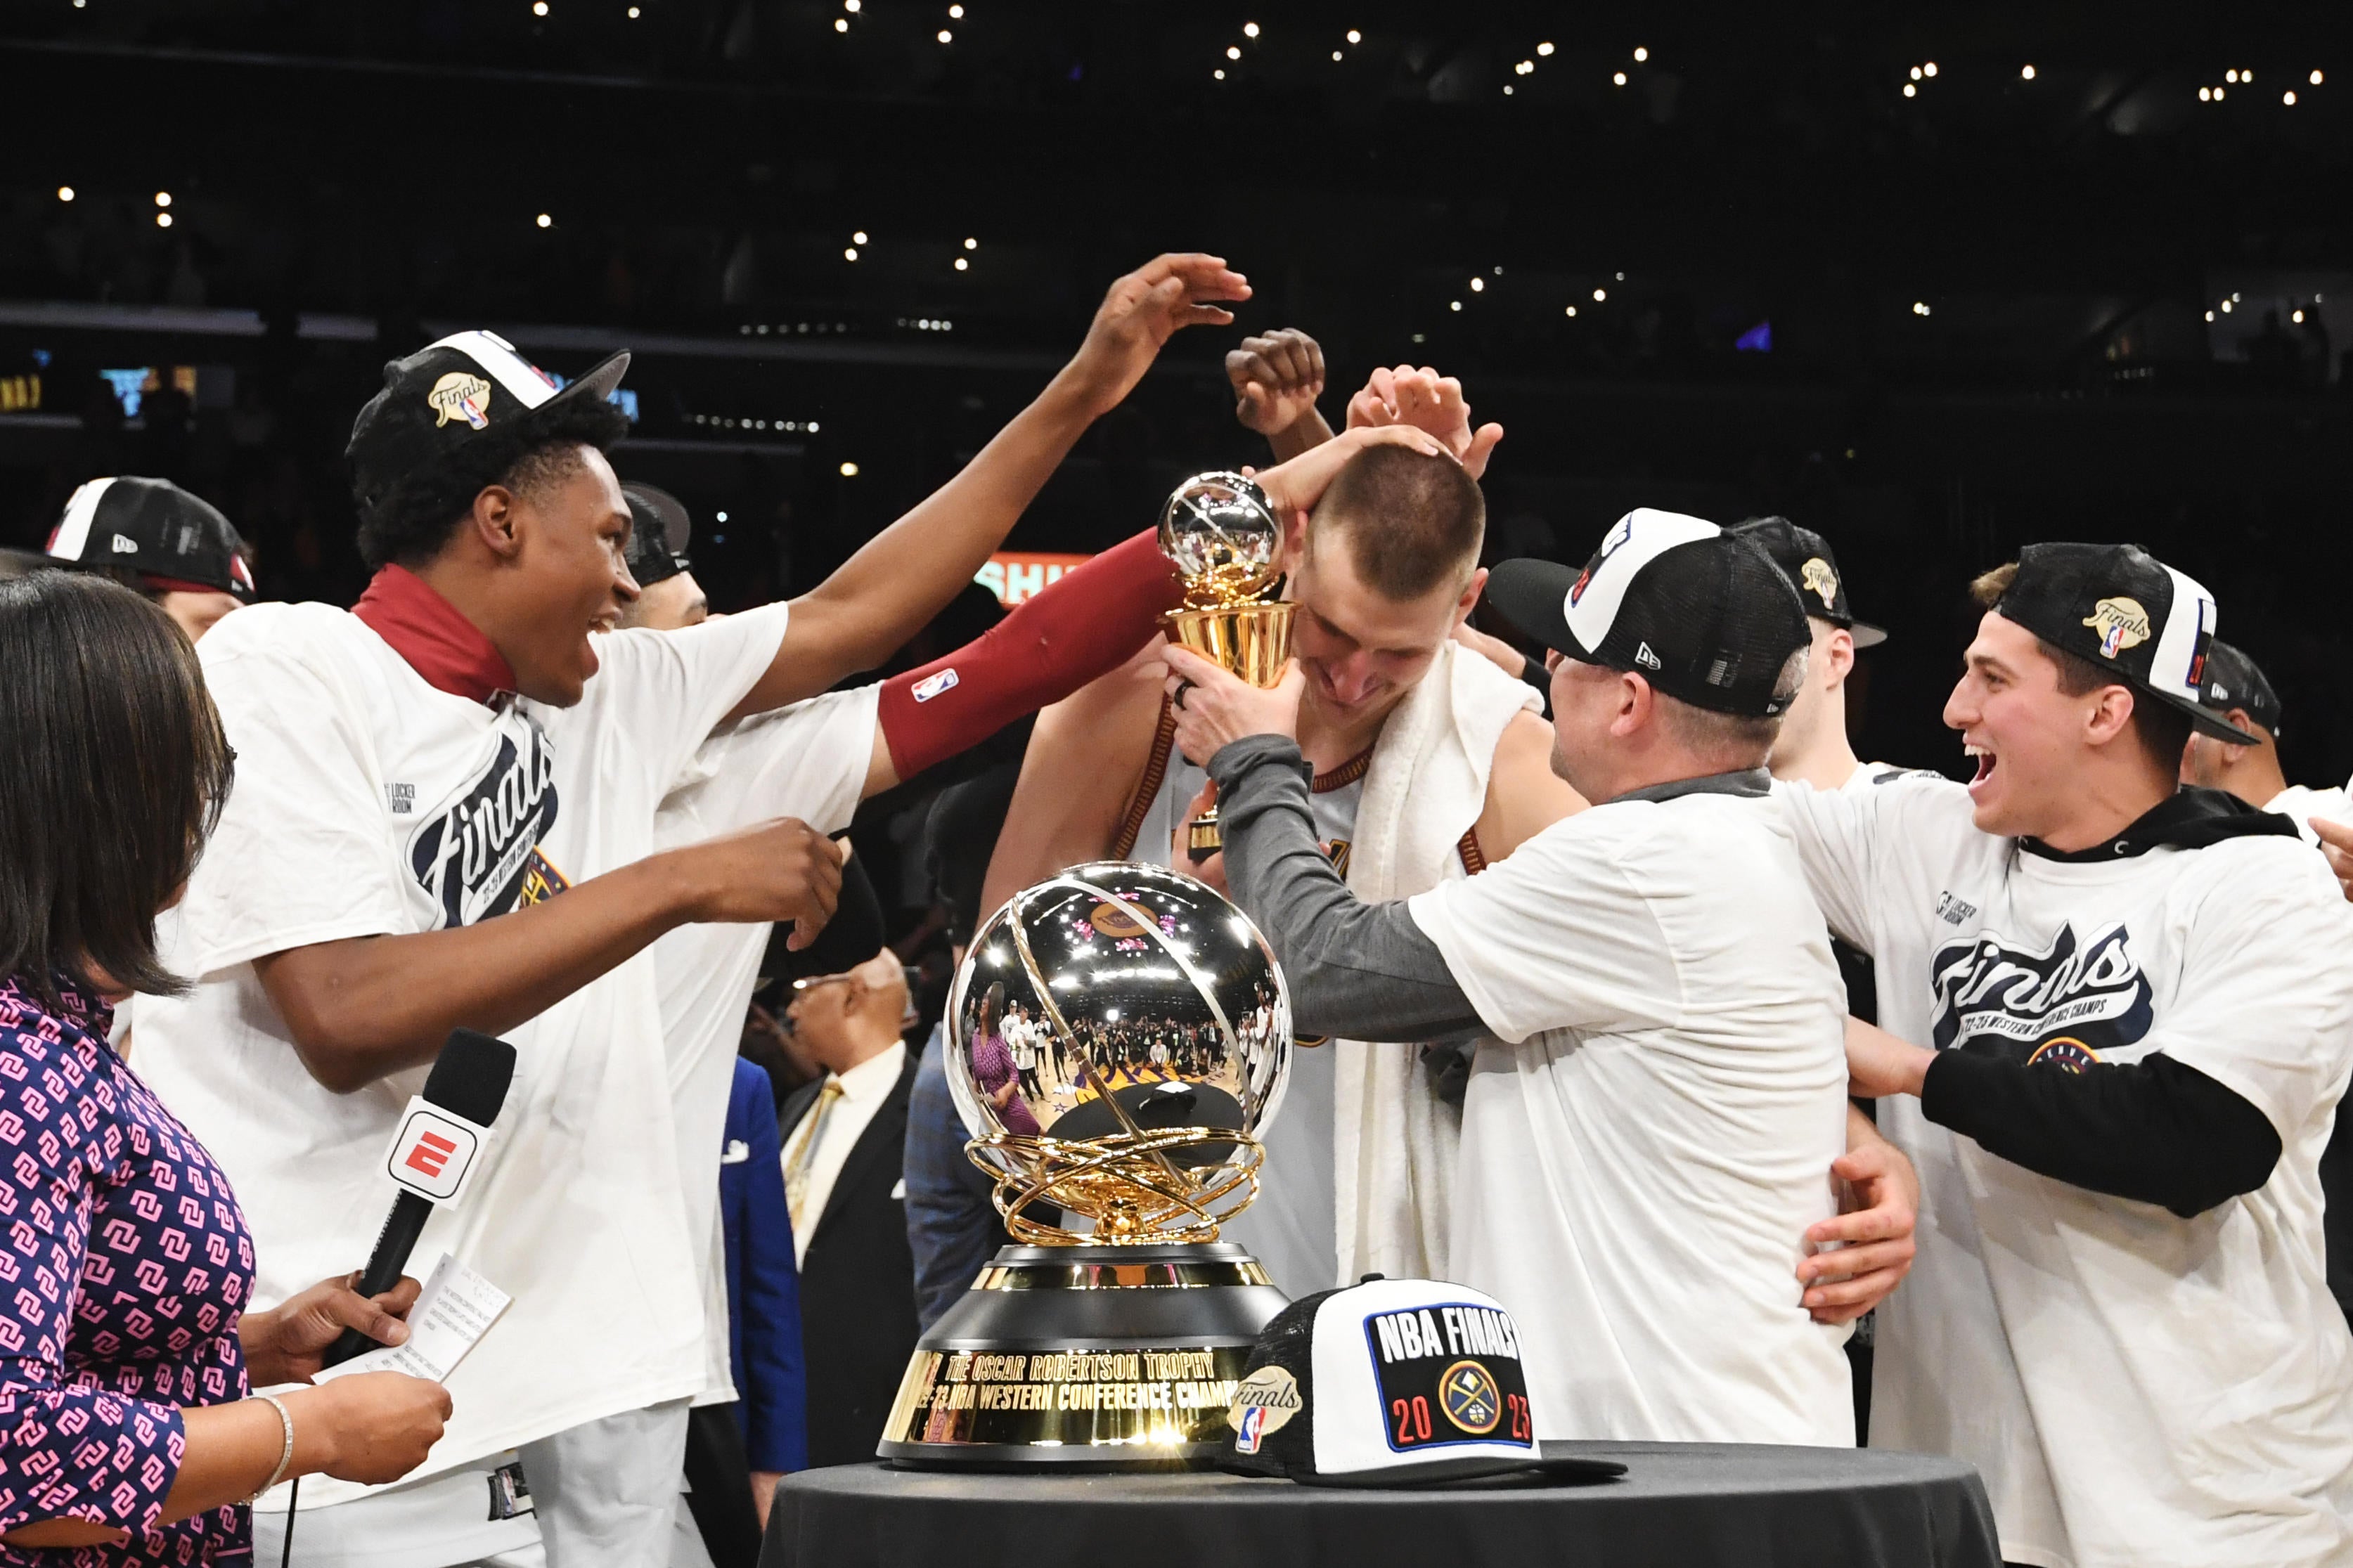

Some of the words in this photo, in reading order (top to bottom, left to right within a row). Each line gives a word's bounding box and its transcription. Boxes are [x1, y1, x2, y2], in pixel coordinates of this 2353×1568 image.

[432, 377, 488, 425] Finals
[973, 562, 1078, 604] SH
[2084, 602, 2148, 637] Finals
[392, 783, 415, 799] LOCKER
[392, 797, 412, 814] ROOM
[2070, 999, 2107, 1019] CHAMPS
[1376, 1309, 1444, 1363] NBA
[1441, 1307, 1519, 1360] FINALS
[945, 1355, 972, 1382] THE
[972, 1355, 1026, 1382] OSCAR
[1029, 1353, 1139, 1382] ROBERTSON
[1144, 1352, 1215, 1380] TROPHY
[948, 1384, 976, 1410] NBA
[979, 1384, 1054, 1410] WESTERN
[1057, 1382, 1172, 1410] CONFERENCE
[1233, 1380, 1299, 1408] Finals
[1393, 1395, 1432, 1444] 20
